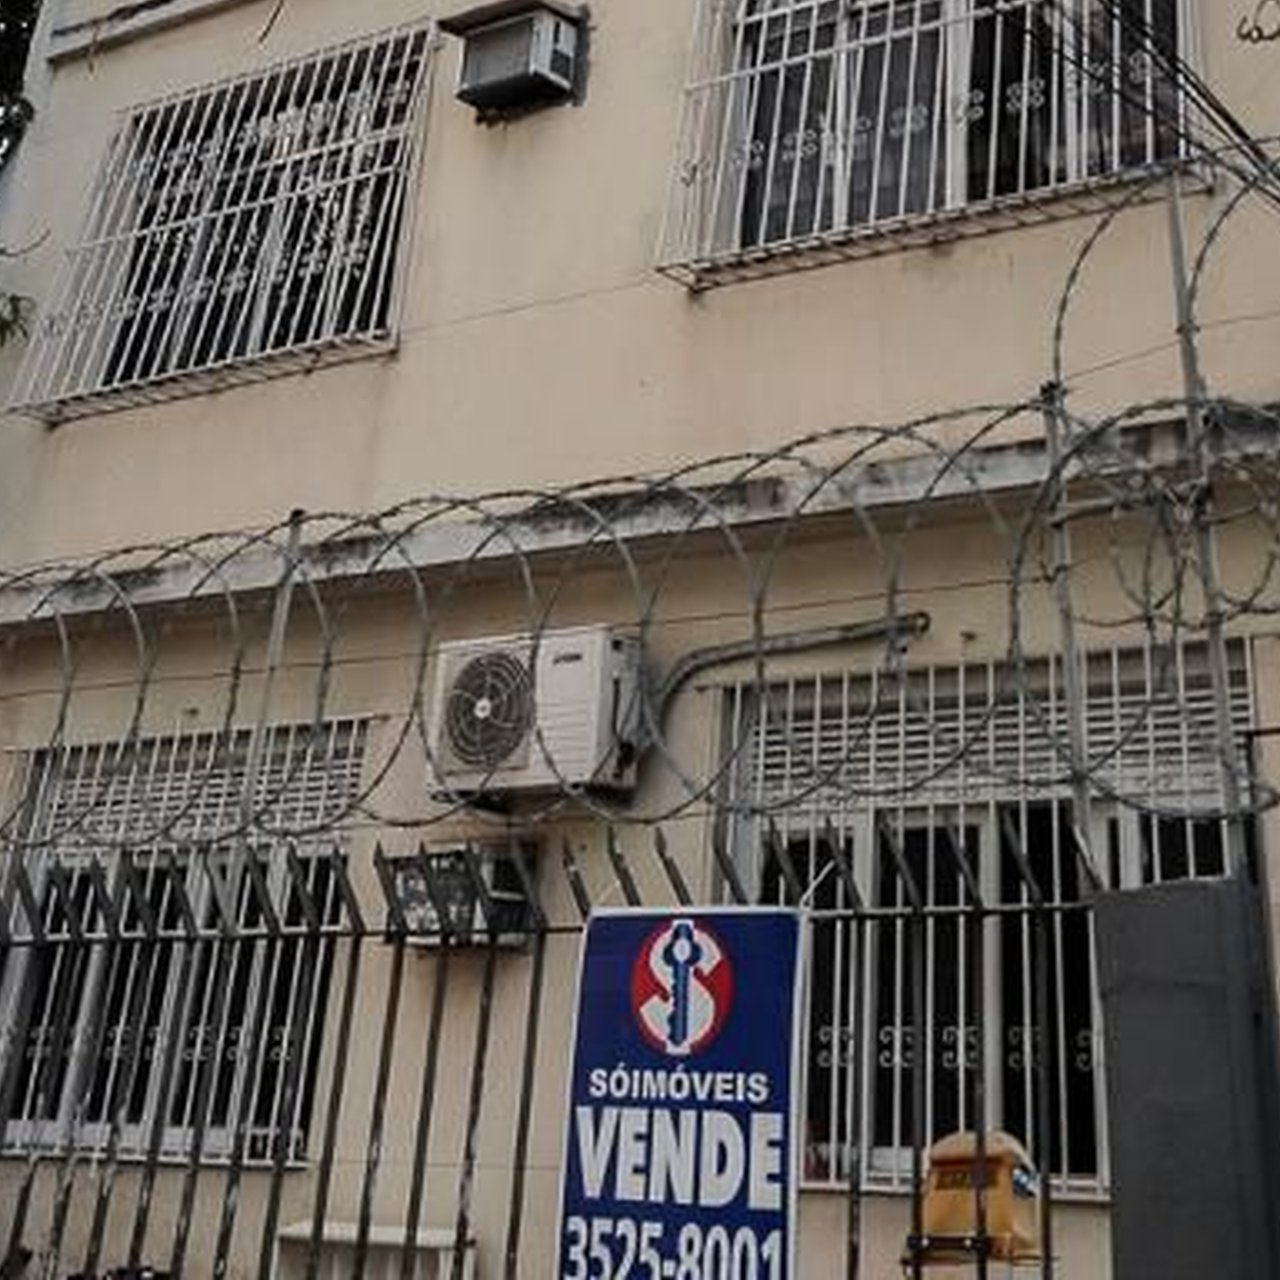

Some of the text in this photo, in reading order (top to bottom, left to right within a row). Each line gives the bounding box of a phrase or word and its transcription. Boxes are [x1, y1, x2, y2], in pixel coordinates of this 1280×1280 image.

[588, 1063, 769, 1102] SÓIMÓVEIS
[576, 1106, 783, 1211] VENDE
[563, 1216, 782, 1280] 3525-8001
